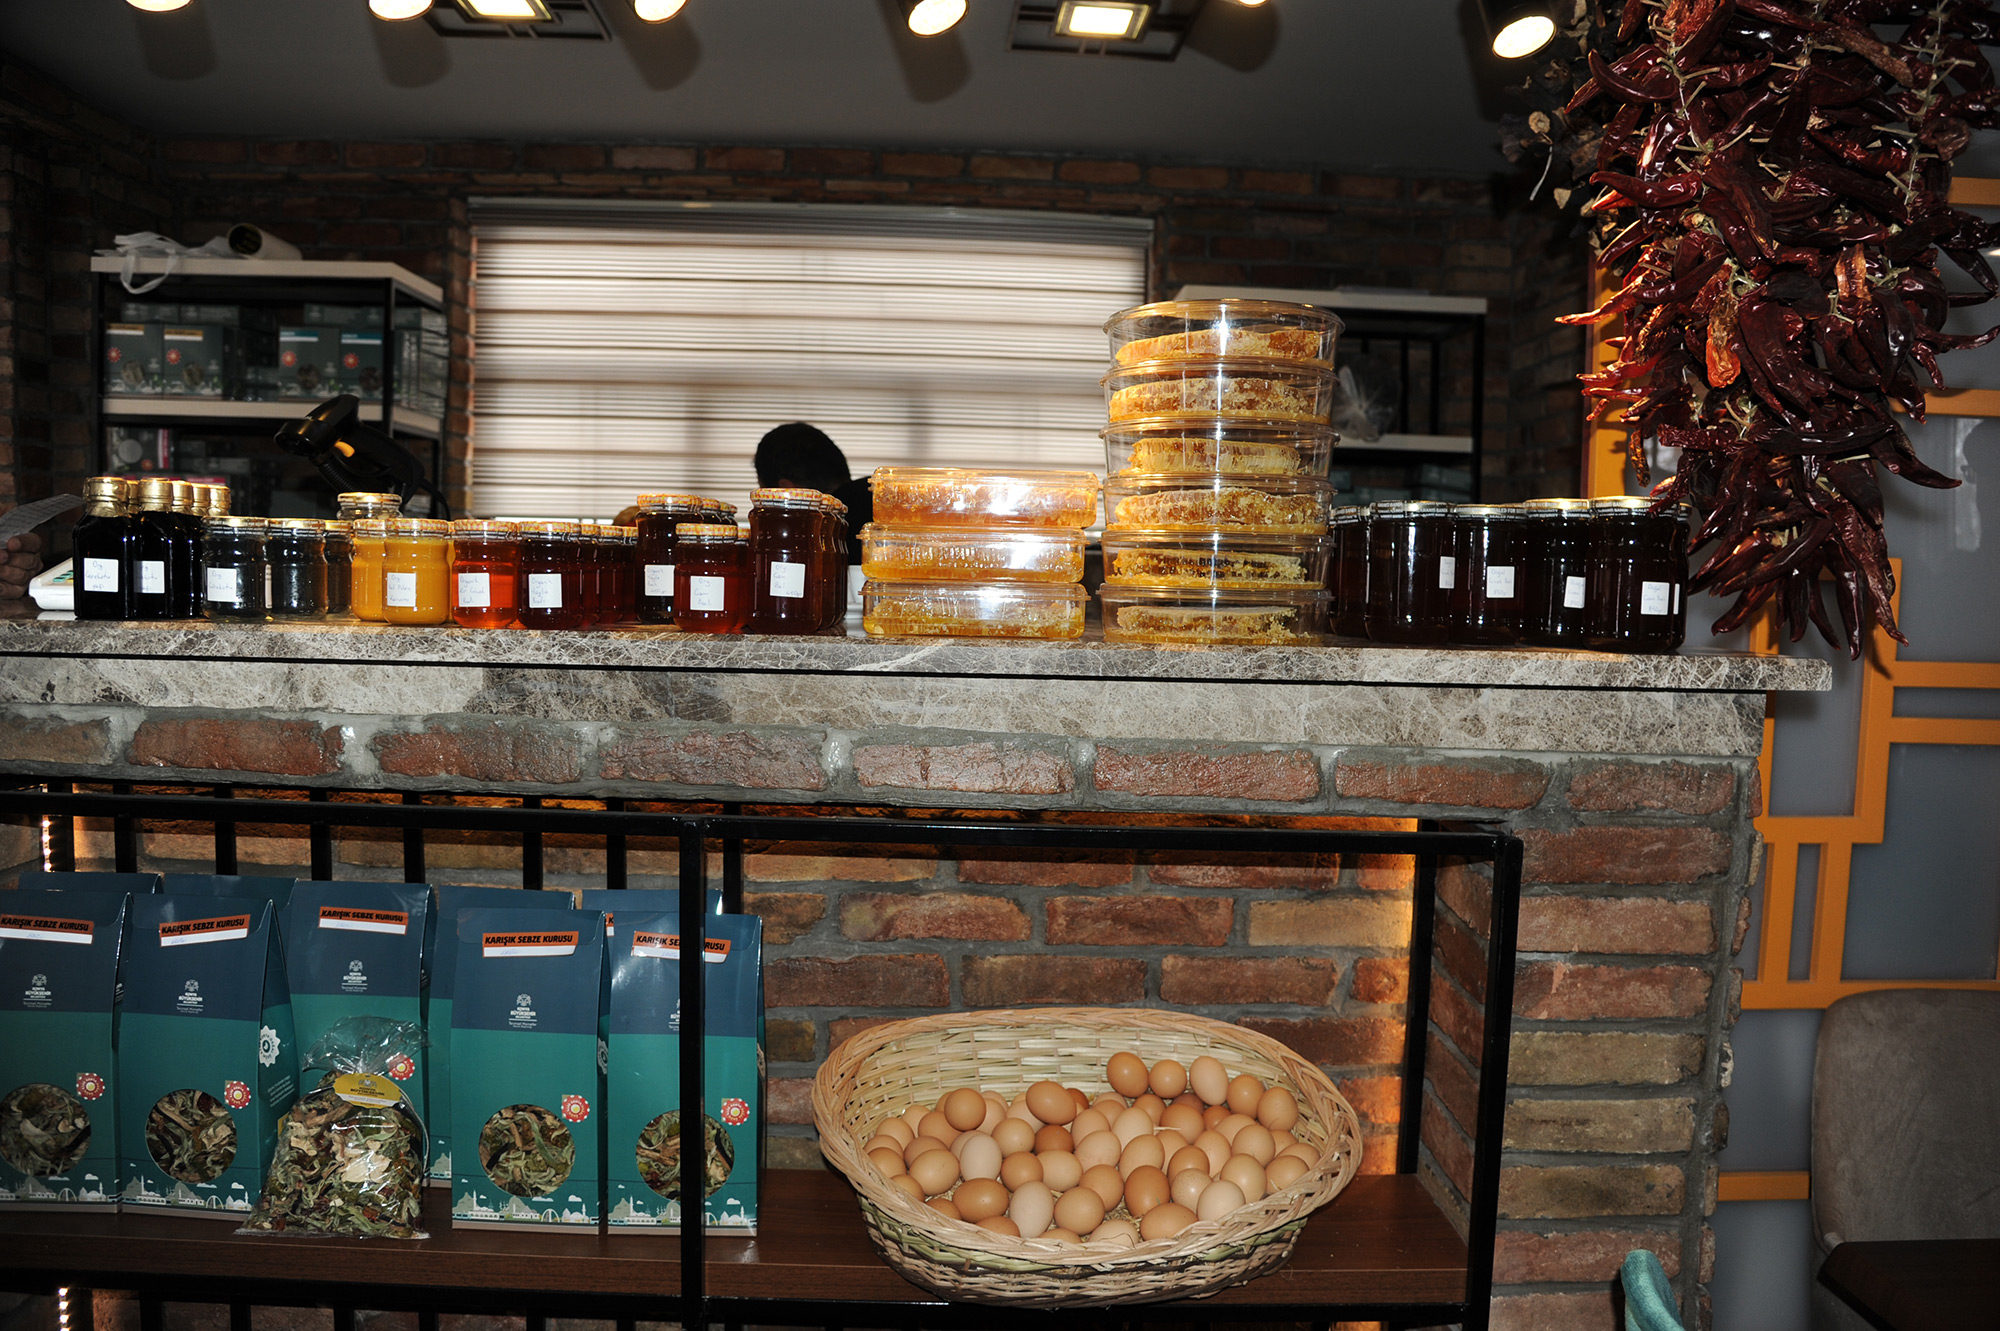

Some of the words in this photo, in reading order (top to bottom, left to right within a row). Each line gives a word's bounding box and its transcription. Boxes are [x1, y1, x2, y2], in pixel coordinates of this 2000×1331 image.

[321, 909, 351, 920] KARIŞIK
[352, 911, 374, 920] SEBZE
[375, 913, 404, 922] KURUSU
[0, 917, 34, 929] KARIŞIK
[33, 919, 58, 929] SEBZE
[58, 921, 90, 931] KURUSU
[161, 924, 192, 935] KARIŞIK
[192, 921, 215, 931] SEBZE
[216, 918, 245, 929] KURUSU
[485, 936, 516, 946] KARIŞIK
[517, 935, 542, 944] SEBZE
[542, 934, 573, 943] KURUSU
[636, 935, 667, 945] KARIŞIK
[705, 941, 725, 951] RUSU
